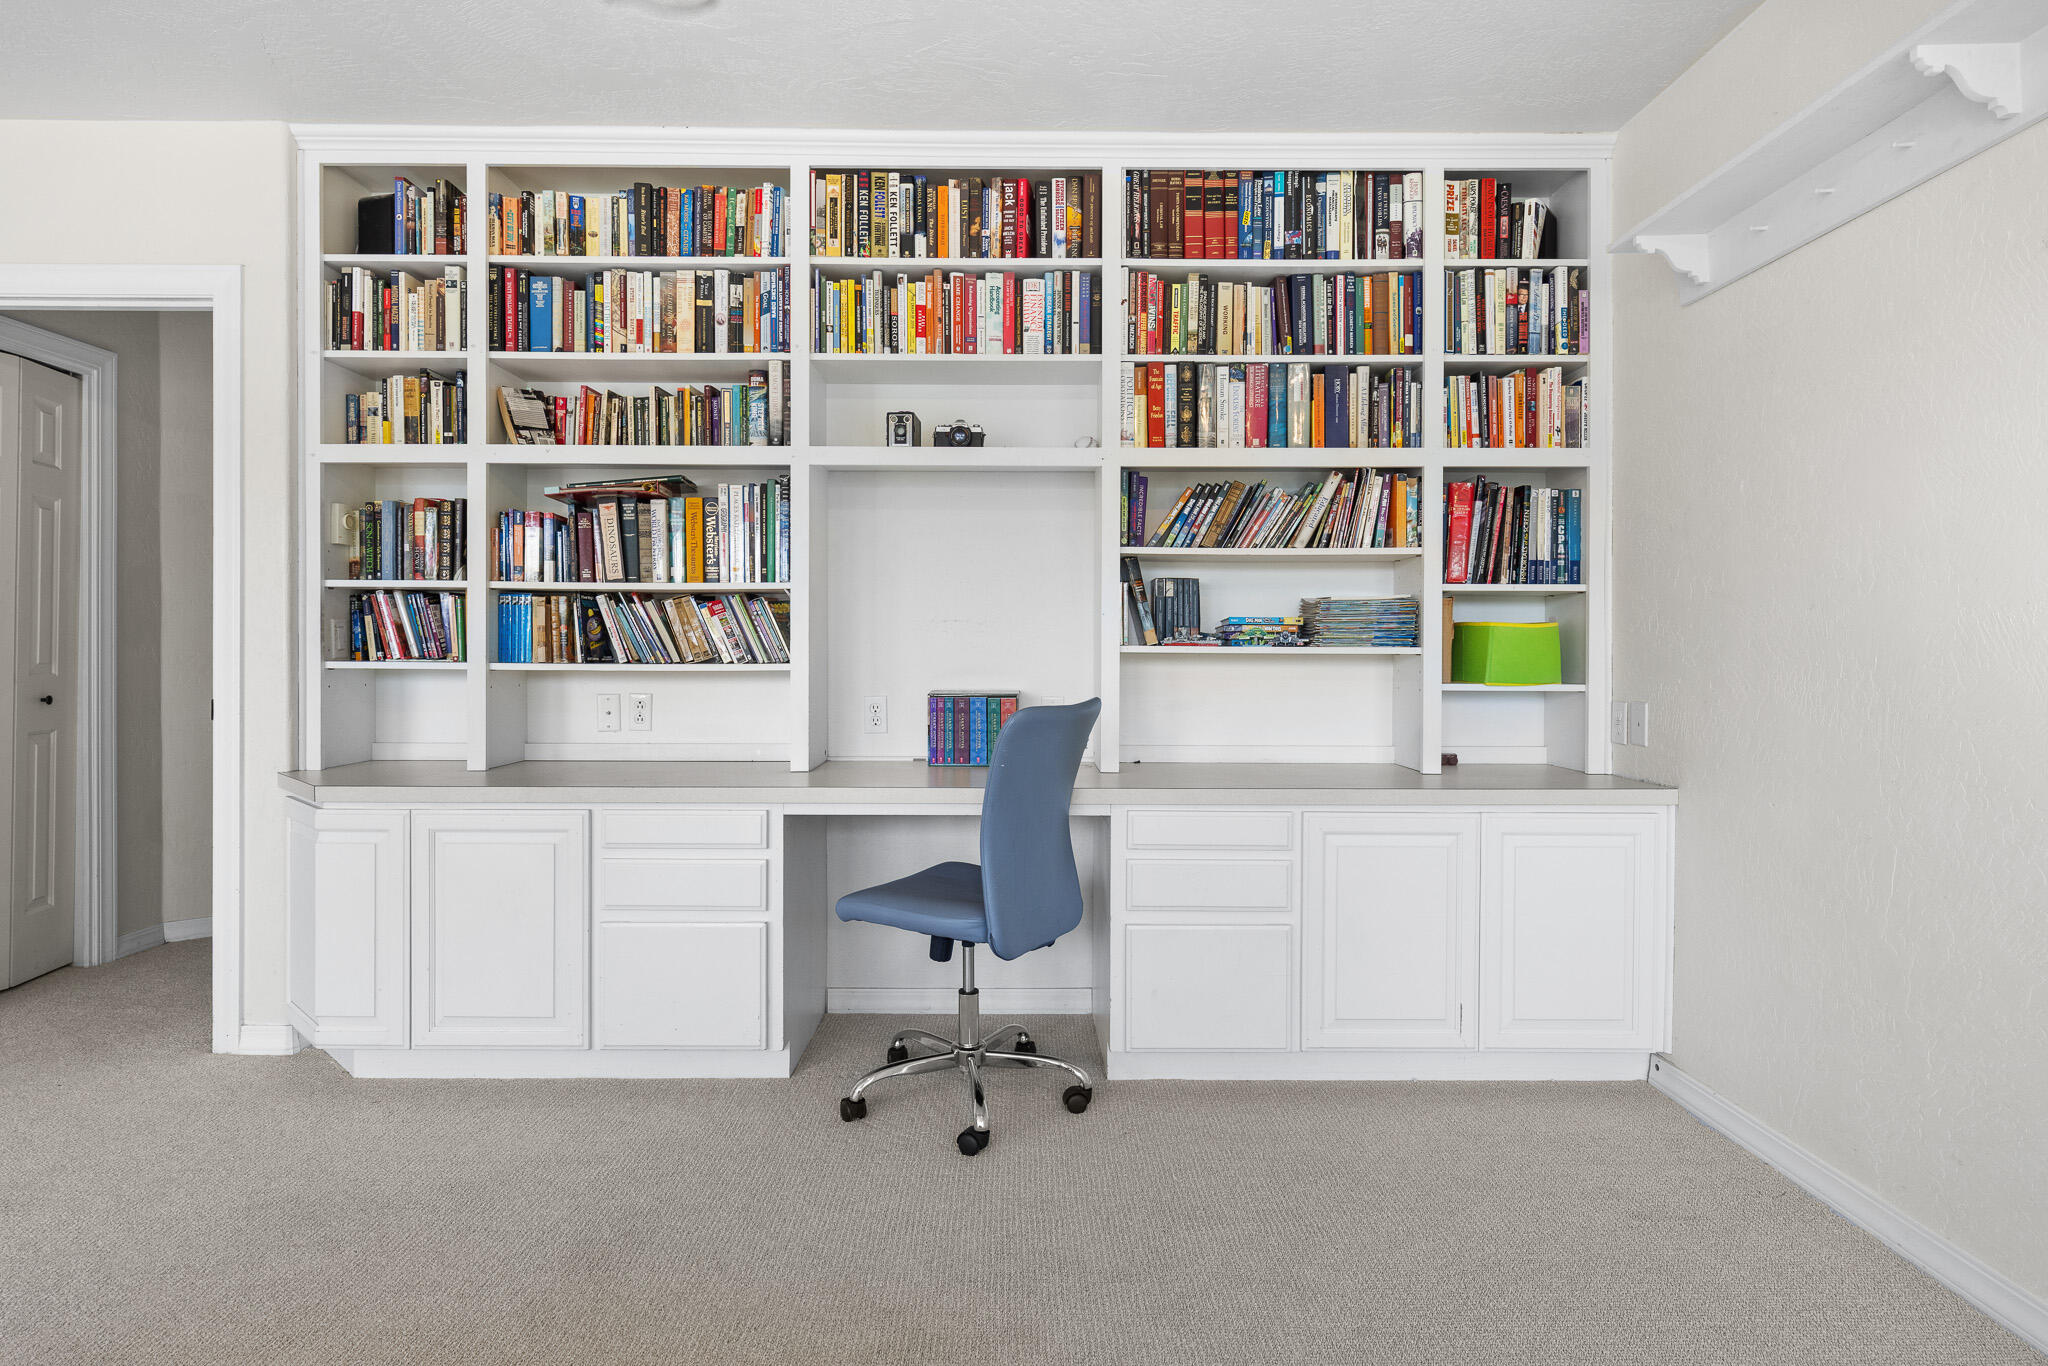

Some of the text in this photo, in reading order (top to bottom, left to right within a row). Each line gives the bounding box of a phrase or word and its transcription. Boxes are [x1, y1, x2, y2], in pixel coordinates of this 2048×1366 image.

[874, 176, 886, 219] KEN FOLLETT
[1003, 183, 1016, 206] jack
[1305, 194, 1313, 232] ECONOMICS
[1446, 183, 1455, 212] PRIZE
[1468, 180, 1477, 214] LIAR'S POKER
[1500, 190, 1509, 216] CAESAR
[859, 189, 869, 245] KEN FOLLETT
[890, 191, 898, 248] KEN FOLLETT
[1019, 220, 1024, 229] TO
[1039, 197, 1047, 255] The Unfinished Presidency
[391, 285, 399, 324] MORAL MAZES
[1148, 277, 1156, 330] MOLLY IVINS
[1219, 374, 1227, 421] Human Smoke
[1137, 484, 1145, 518] INCREDIBLE
[1308, 496, 1329, 530] Educated
[606, 517, 620, 574] DINOSAURS
[690, 511, 698, 575] Webster's Thesaurus
[705, 515, 716, 565] Webster's
[1557, 525, 1565, 554] CPA
[1520, 546, 1528, 582] IMMORTALS
